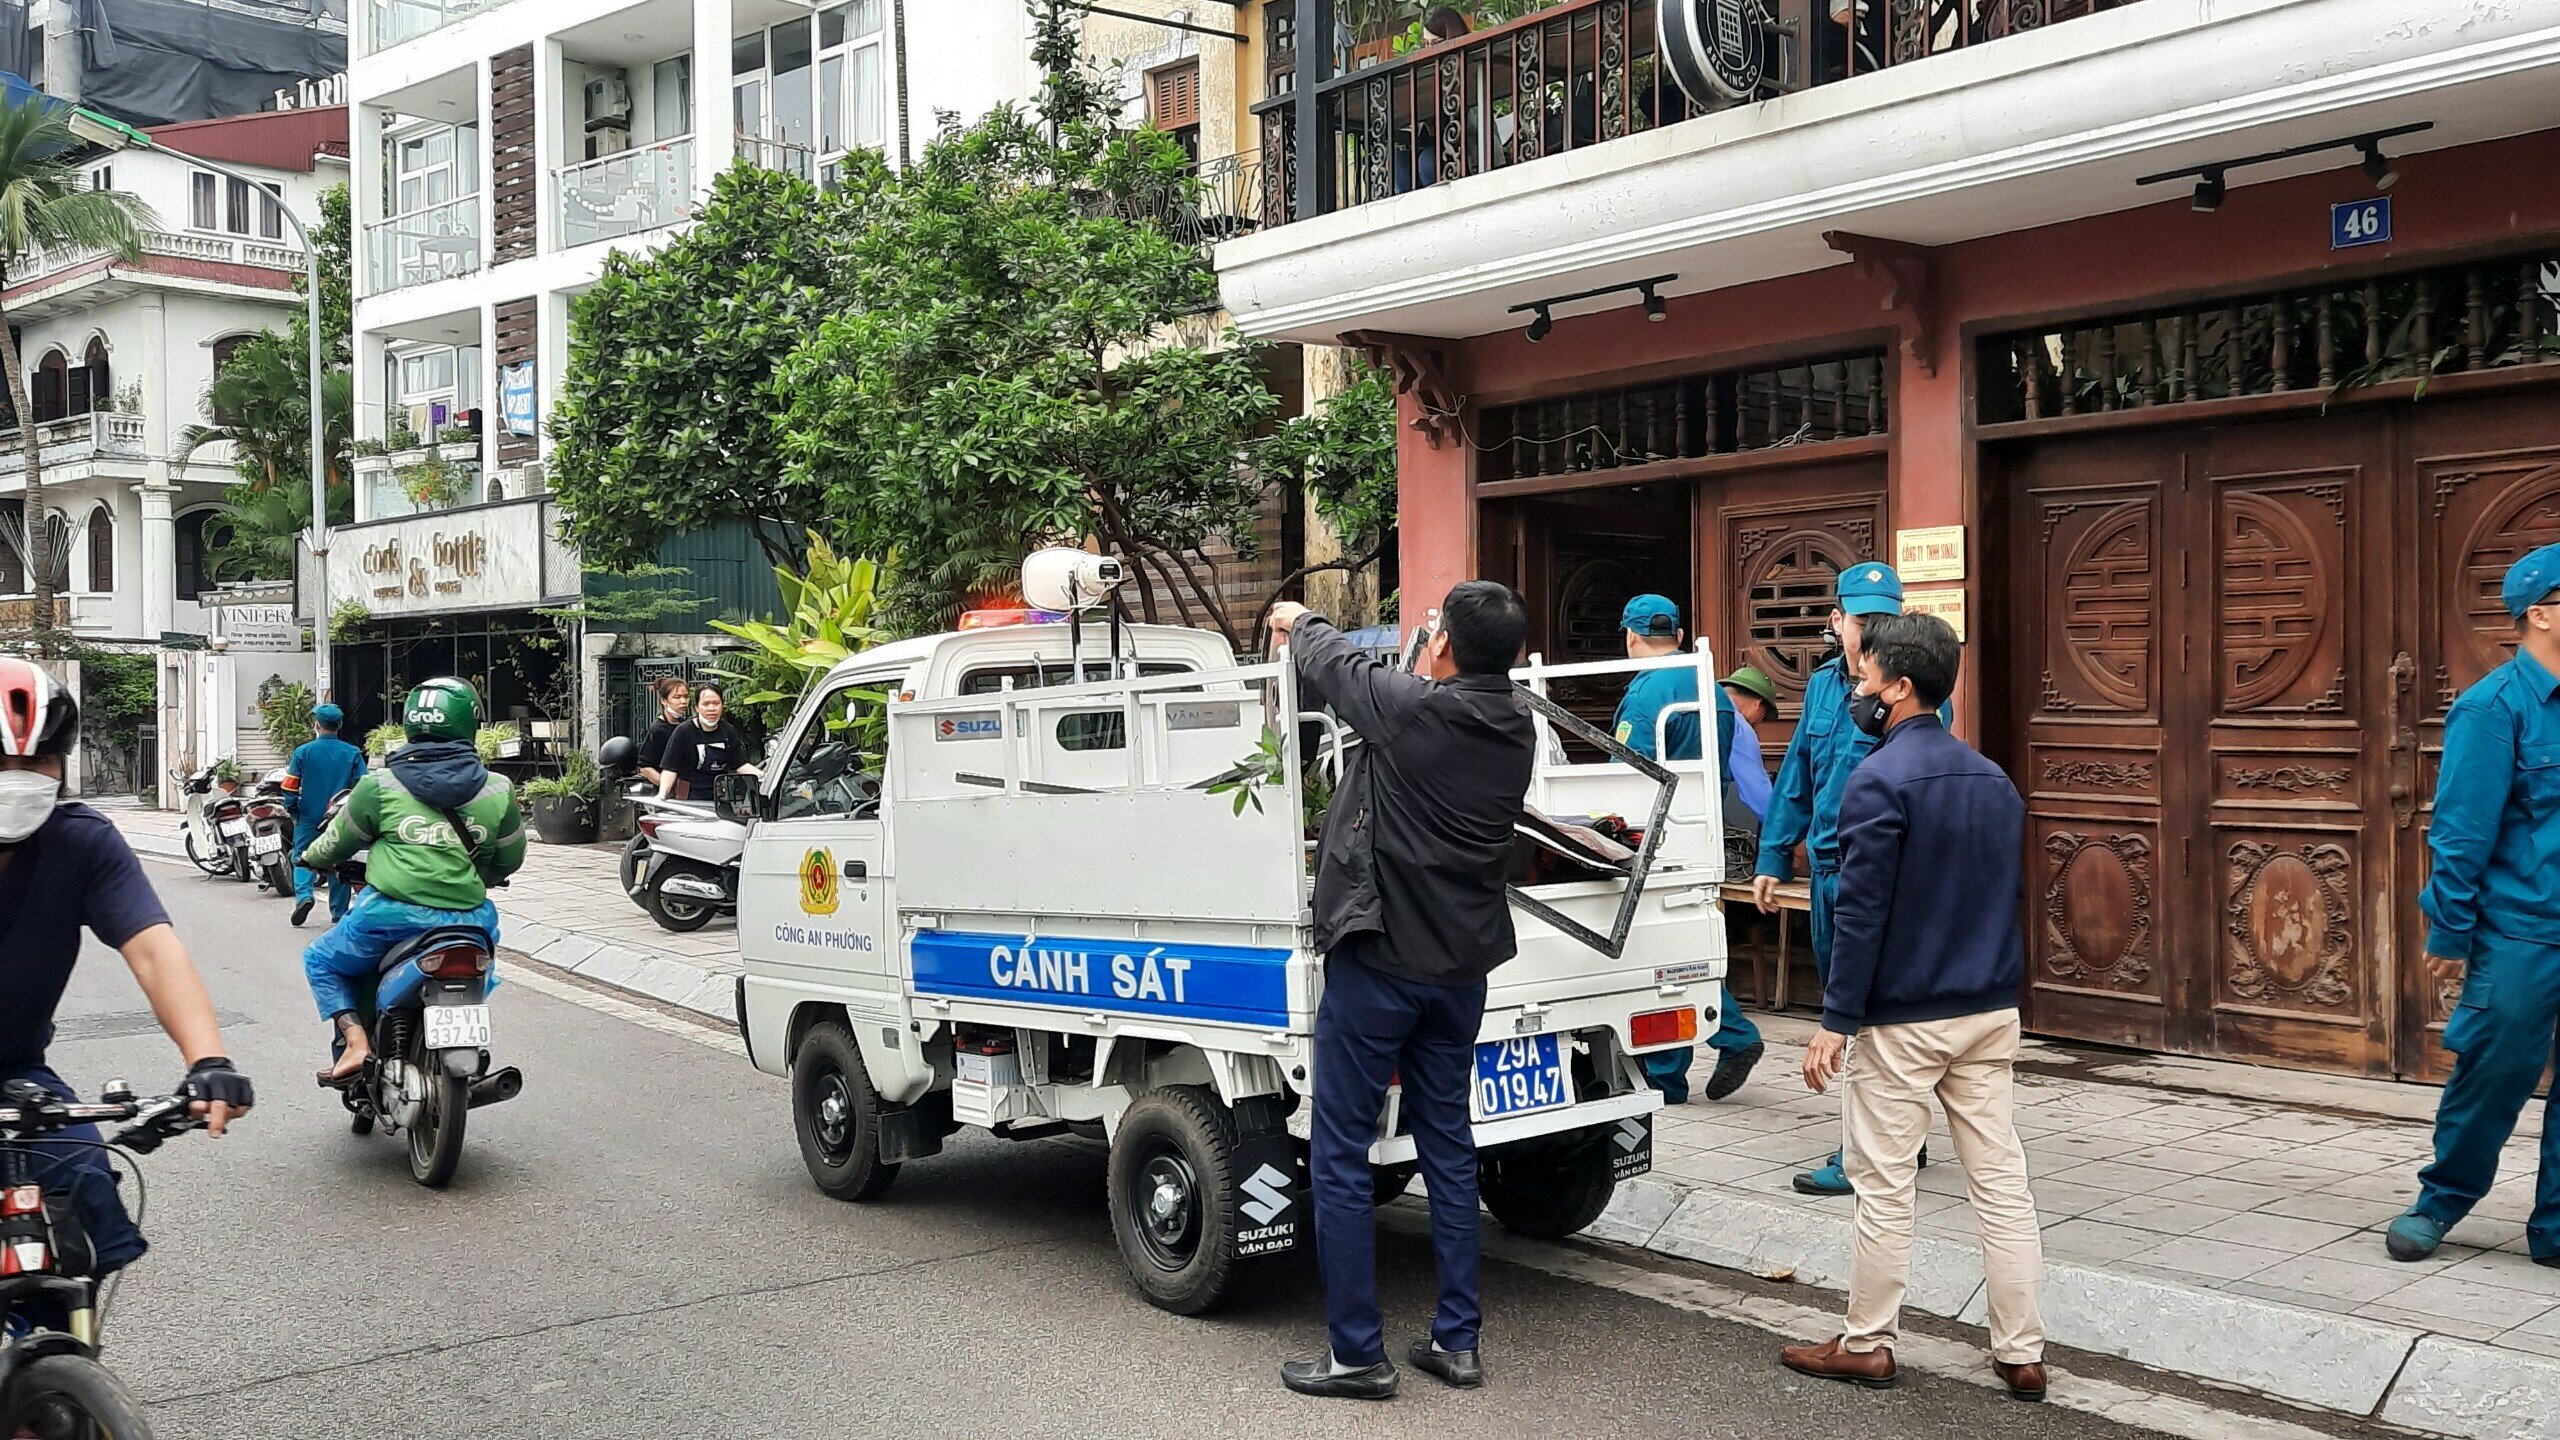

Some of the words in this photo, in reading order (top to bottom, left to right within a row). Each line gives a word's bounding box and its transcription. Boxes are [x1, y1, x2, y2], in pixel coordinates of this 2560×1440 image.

[1706, 46, 1745, 88] BREWING
[1746, 65, 1758, 83] CO
[2344, 206, 2379, 239] 46
[408, 556, 430, 597] &
[432, 529, 487, 578] bottle
[408, 711, 445, 724] Grab
[398, 815, 488, 844] Grab
[775, 922, 805, 944] CÔNG
[808, 930, 822, 946] AN
[825, 927, 872, 952] PHƯỜNG
[1111, 947, 1191, 1003] SÁT
[435, 1009, 481, 1025] 29-V1
[430, 1027, 488, 1046] 337.40
[1495, 1036, 1541, 1072] 29A
[1481, 1066, 1560, 1113] 019.47
[1612, 1150, 1650, 1168] SUZUKI
[1237, 1223, 1294, 1242] SUZUKI
[1238, 1243, 1264, 1255] VÂN
